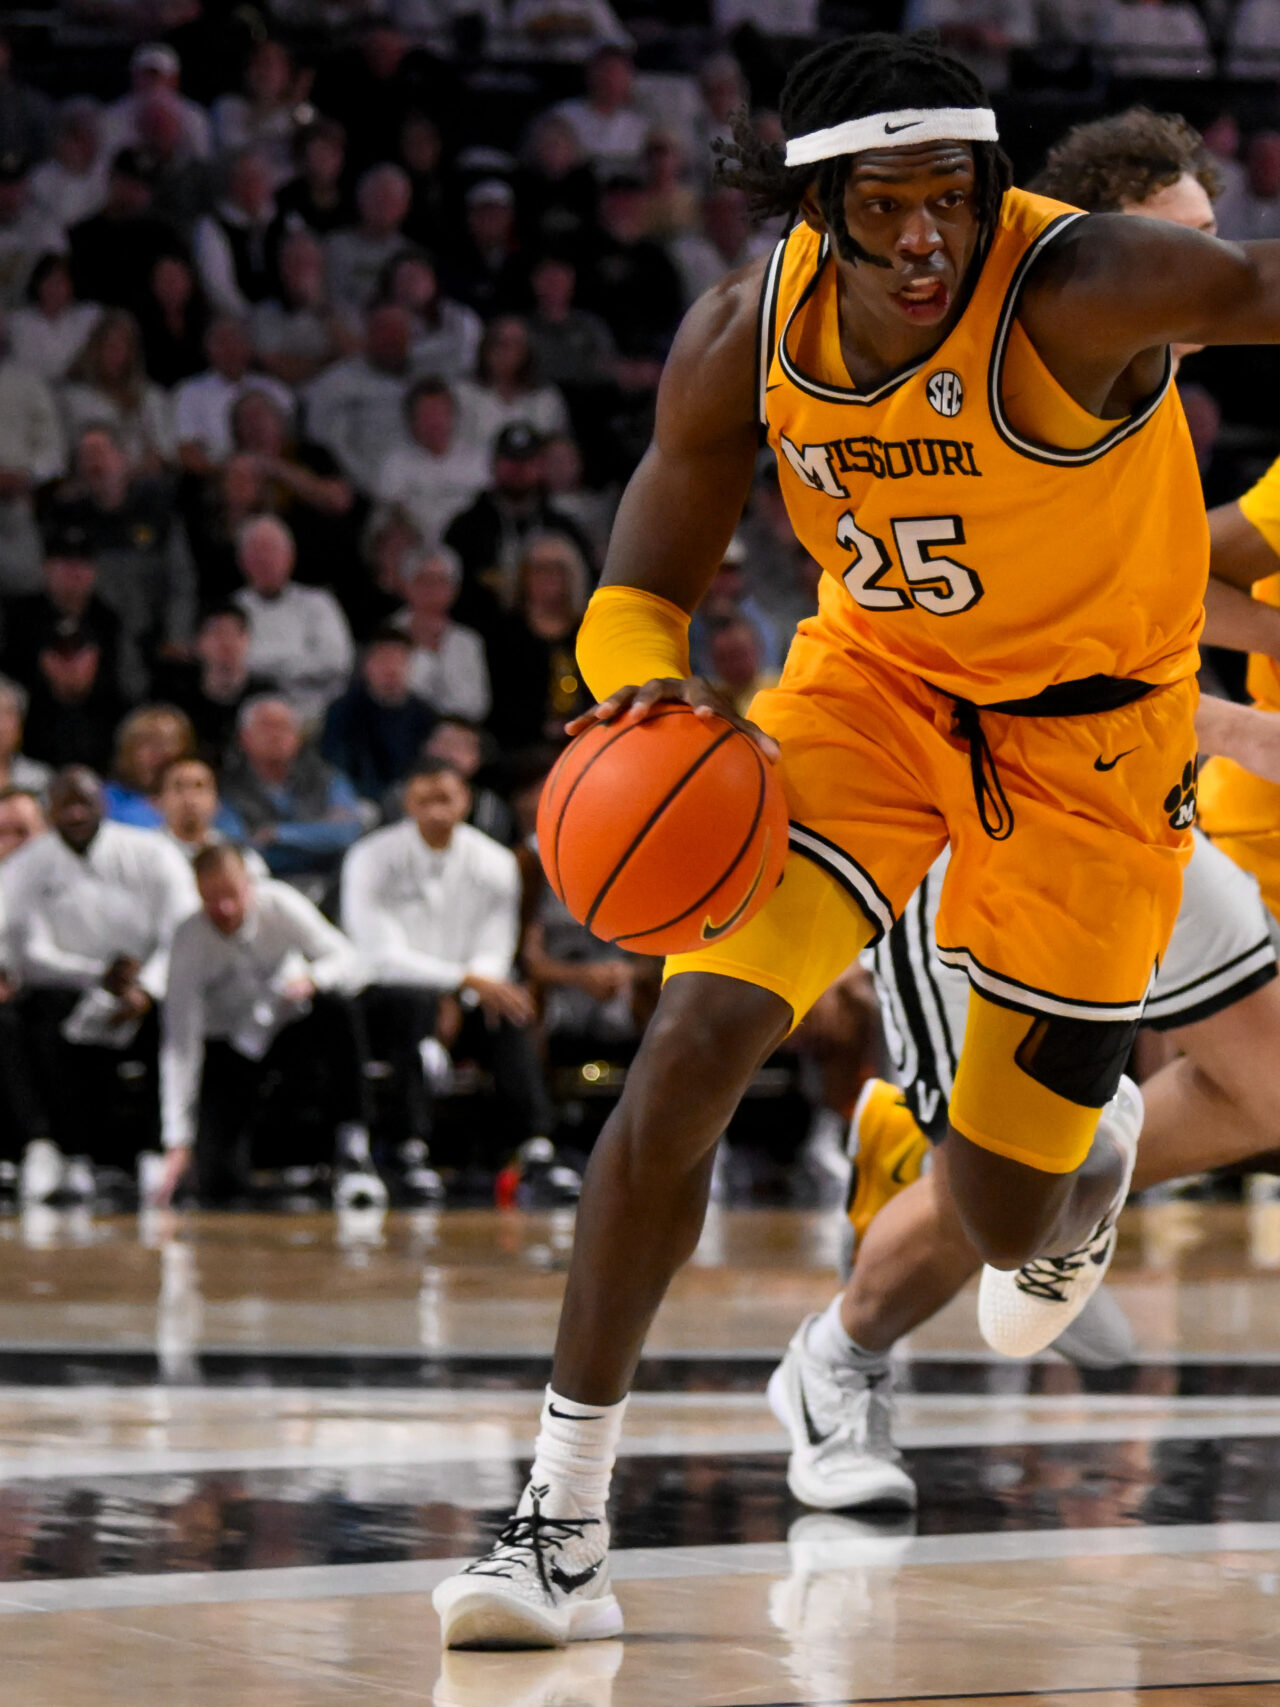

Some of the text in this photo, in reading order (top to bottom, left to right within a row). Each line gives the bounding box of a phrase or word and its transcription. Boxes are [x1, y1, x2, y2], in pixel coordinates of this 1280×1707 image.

[928, 372, 963, 416] SEC
[781, 434, 982, 498] MISSOURI
[837, 511, 984, 616] 25
[916, 1079, 941, 1124] V
